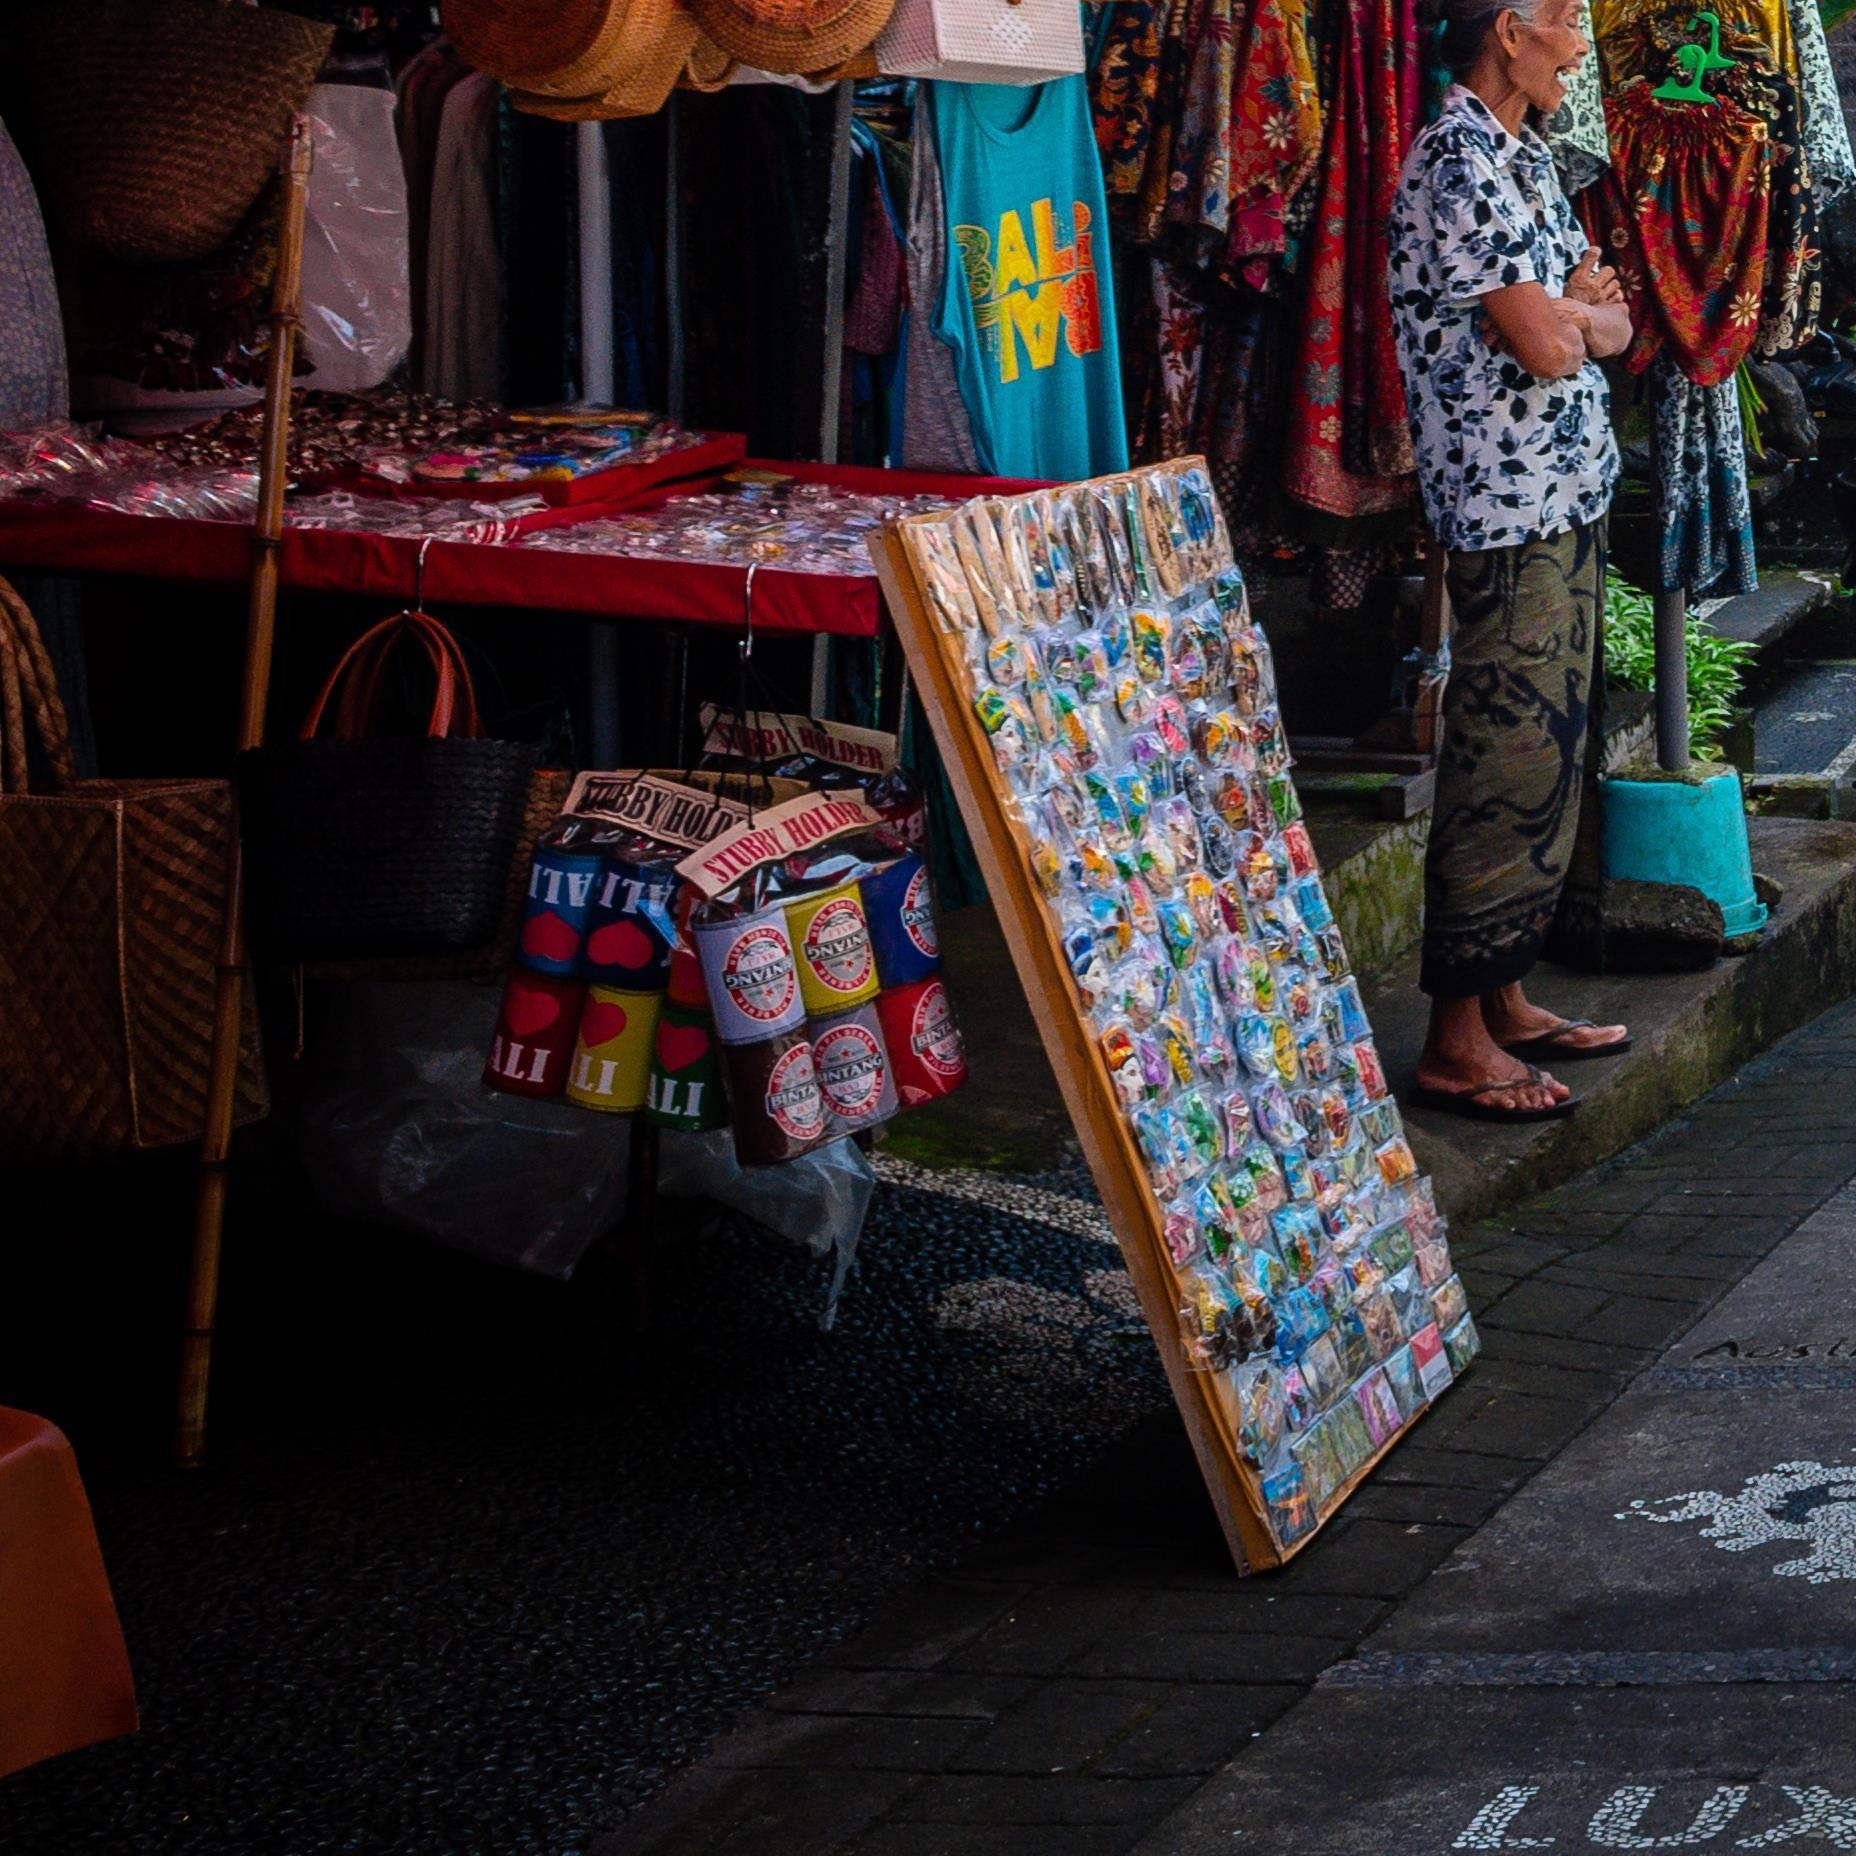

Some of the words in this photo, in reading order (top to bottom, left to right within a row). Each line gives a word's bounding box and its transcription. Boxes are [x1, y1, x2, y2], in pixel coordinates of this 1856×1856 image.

[798, 726, 886, 770] HOLDER
[666, 799, 744, 841] HOLD
[702, 827, 787, 884] STUBBY
[819, 1054, 883, 1084] INTANG
[770, 1082, 820, 1108] BINTA
